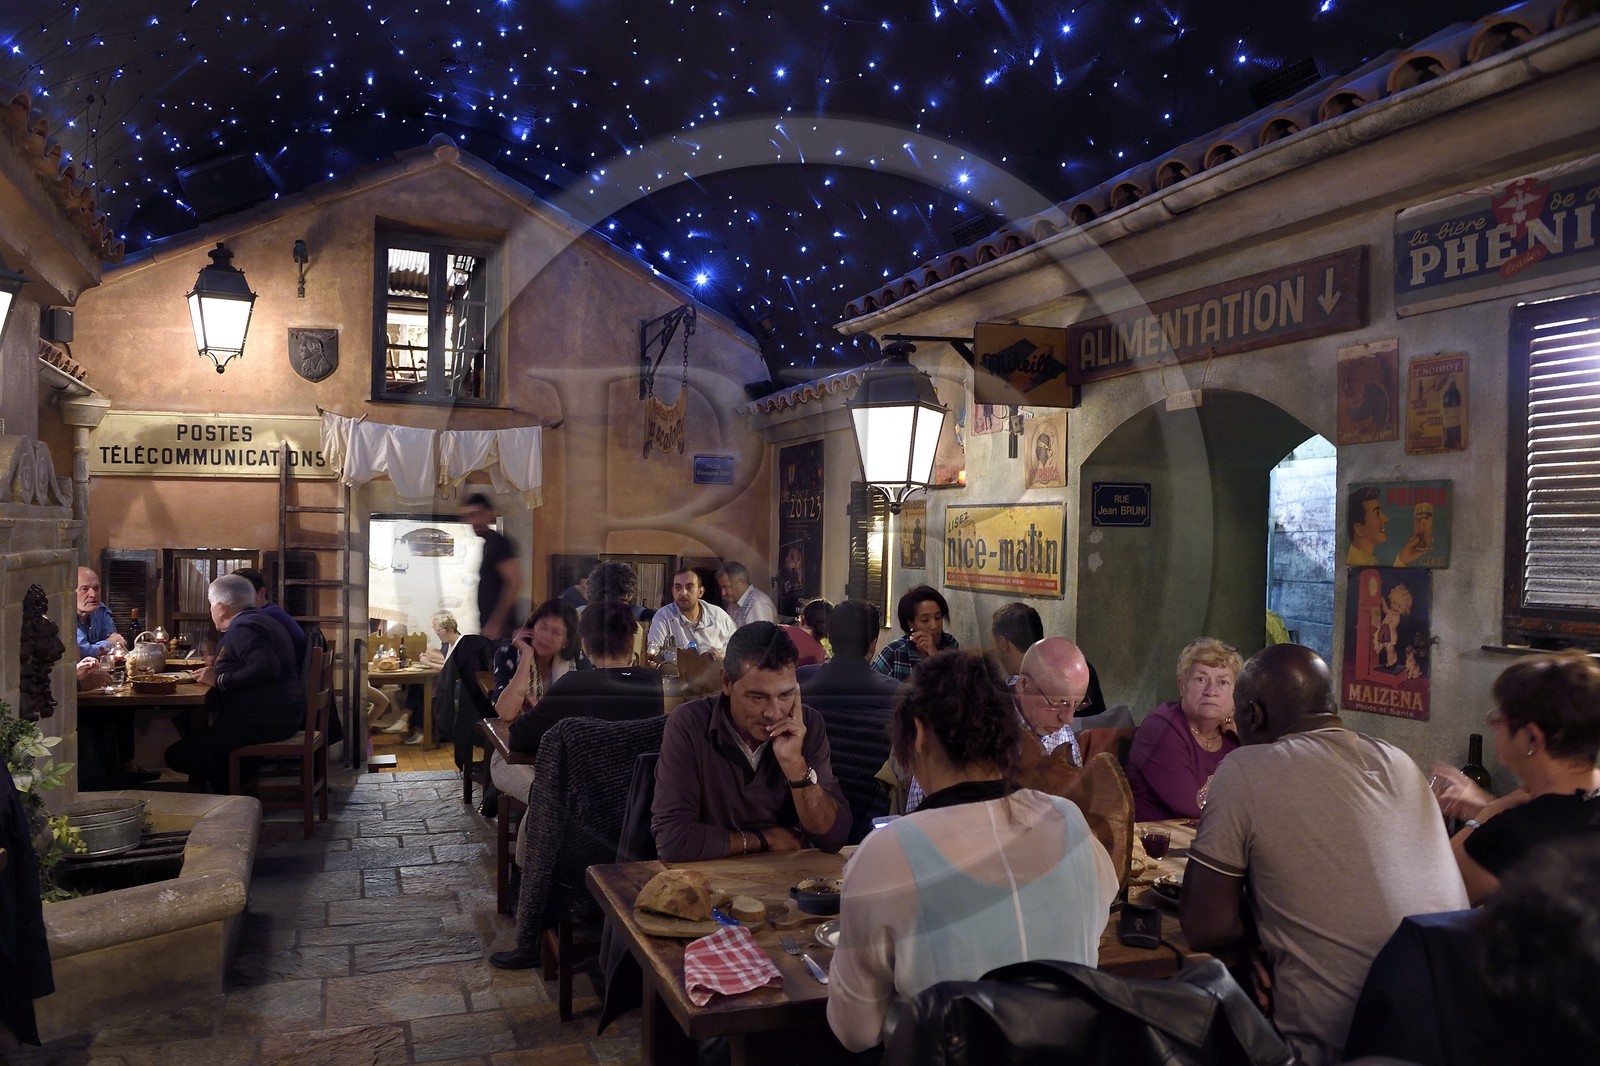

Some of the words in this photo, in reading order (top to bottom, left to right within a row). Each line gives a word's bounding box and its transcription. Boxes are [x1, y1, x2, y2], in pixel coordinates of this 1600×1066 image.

[1408, 229, 1428, 246] la
[1436, 217, 1486, 239] bière
[1550, 192, 1575, 210] de
[1080, 276, 1305, 371] ALIMENTATION
[177, 424, 252, 442] POSTES
[100, 445, 326, 467] TÉLÉCOMMUNICATONS
[1114, 494, 1130, 504] RUE
[1098, 505, 1118, 516] Jean
[1121, 505, 1147, 516] BRUNI
[948, 511, 969, 533] LISEZ
[946, 523, 1058, 575] nice-matin
[1348, 683, 1425, 712] MAIZENA
[1356, 703, 1377, 712] Poids
[1390, 708, 1415, 718] Santé
